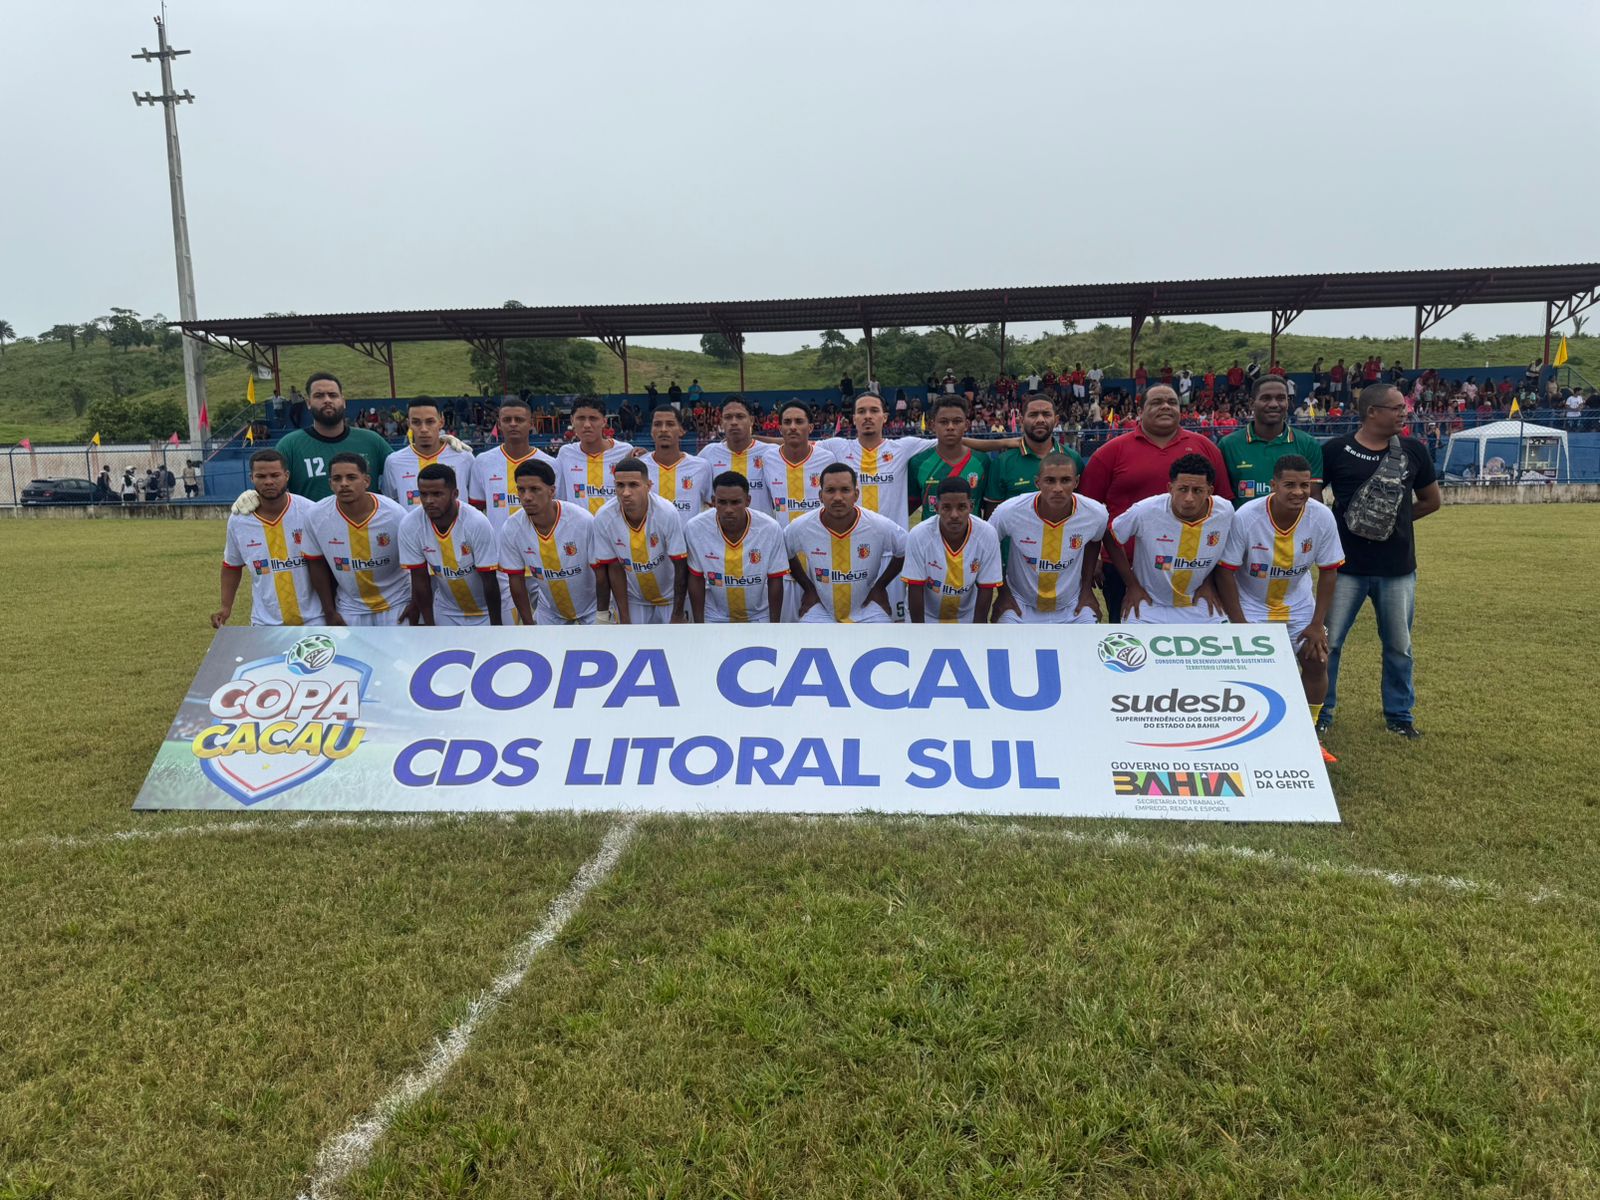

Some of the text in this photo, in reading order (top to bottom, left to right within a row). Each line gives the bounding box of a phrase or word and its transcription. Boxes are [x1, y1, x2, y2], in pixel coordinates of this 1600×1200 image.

[1344, 444, 1380, 461] Emanuel
[304, 456, 327, 478] 12
[860, 473, 894, 483] Ilhéus
[787, 499, 820, 509] Ilhéus
[351, 557, 391, 569] Ilhéus
[633, 554, 665, 571] Ilhéus
[1174, 557, 1212, 569] Ilhéus
[544, 566, 582, 578] Ilhéus
[831, 570, 868, 581] Ilhéus
[1270, 566, 1307, 577] Ilhéus
[724, 575, 762, 585] Ilhéus
[1149, 635, 1275, 656] CDS-LS
[409, 646, 1061, 711] COPA CACAU
[208, 679, 361, 720] COPA
[1110, 688, 1246, 713] sudesb
[191, 721, 367, 760] CACAU
[391, 735, 1060, 789] CDS LITORAL SUL
[1111, 761, 1239, 771] GOVERNO DO ESTADO
[1254, 769, 1310, 779] DO LADO
[1256, 780, 1315, 789] DA GENTE
